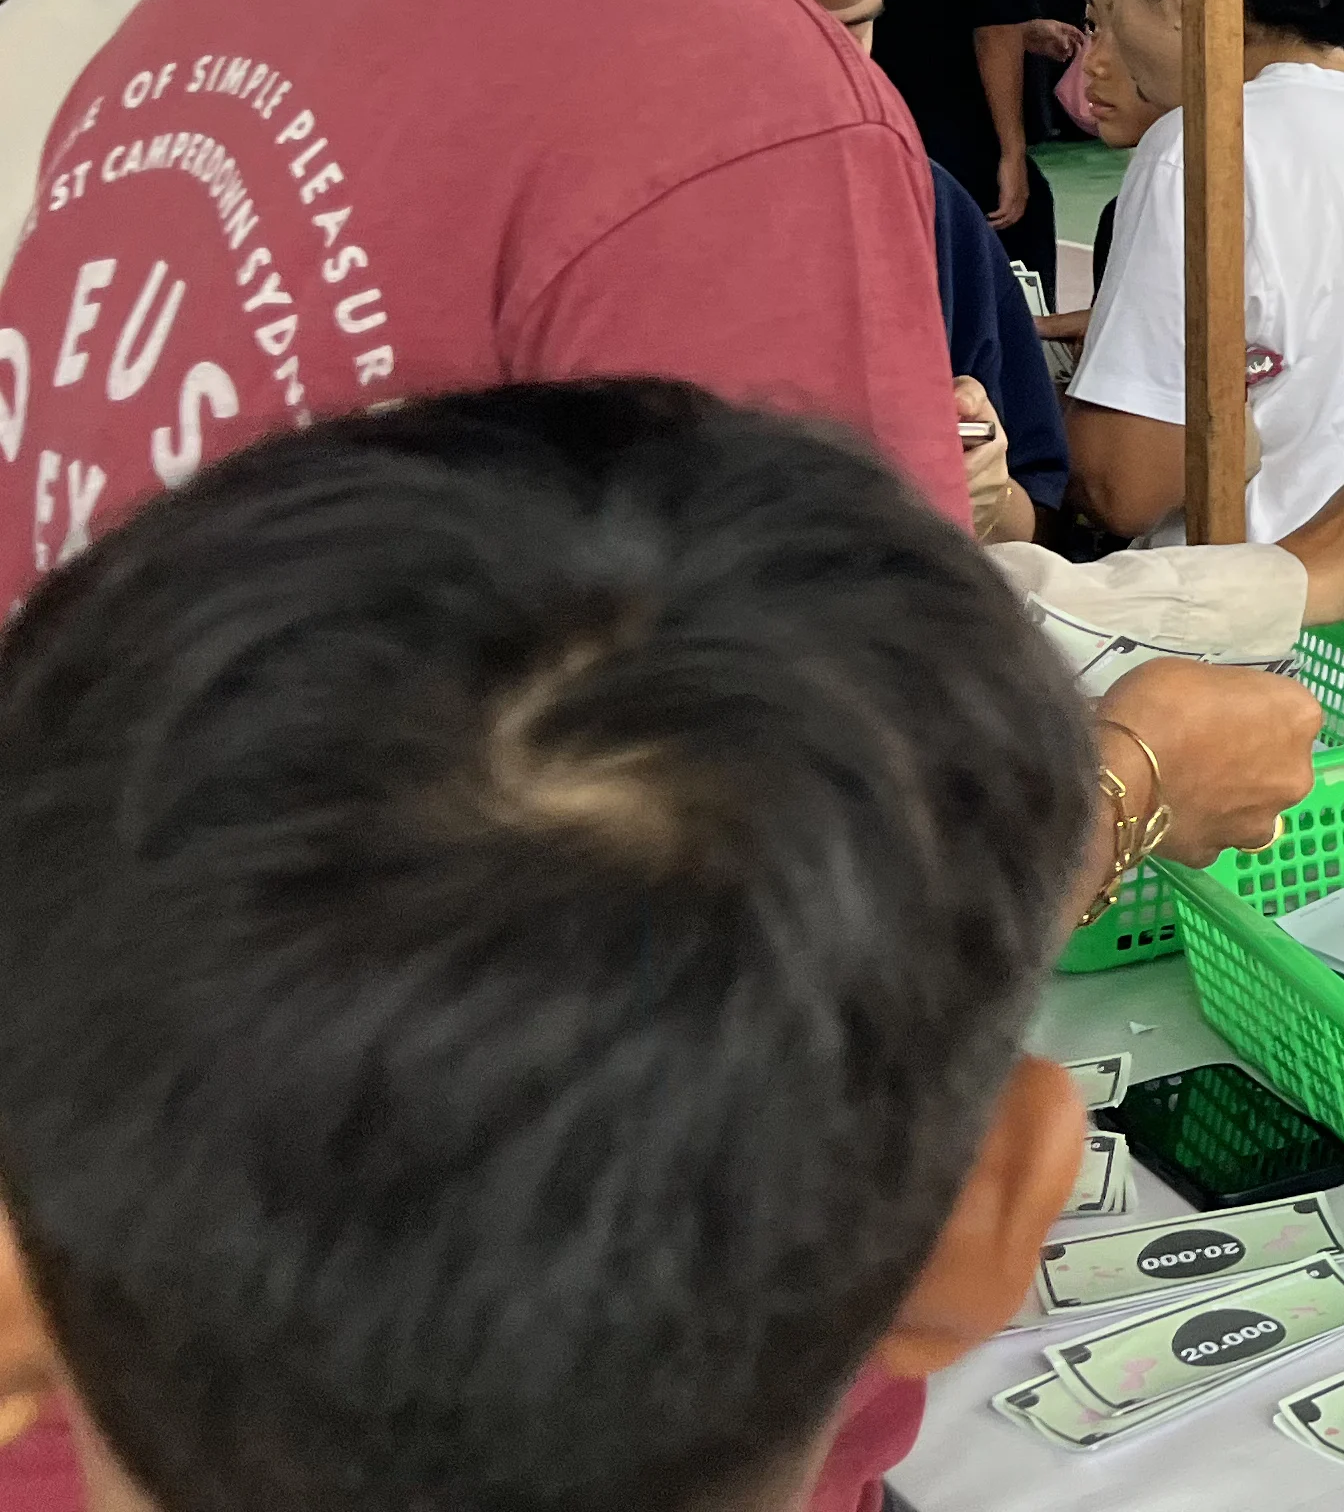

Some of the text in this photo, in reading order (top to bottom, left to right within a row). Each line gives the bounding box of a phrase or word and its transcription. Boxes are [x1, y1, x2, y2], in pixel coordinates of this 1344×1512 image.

[48, 160, 93, 212] ST
[101, 131, 260, 251] CAMPERDOWN
[236, 246, 313, 428] SYDN
[121, 54, 406, 417] OF SIMPLE PLEASUR
[1141, 1241, 1241, 1272] 20.000
[1179, 1319, 1279, 1363] 20.000
